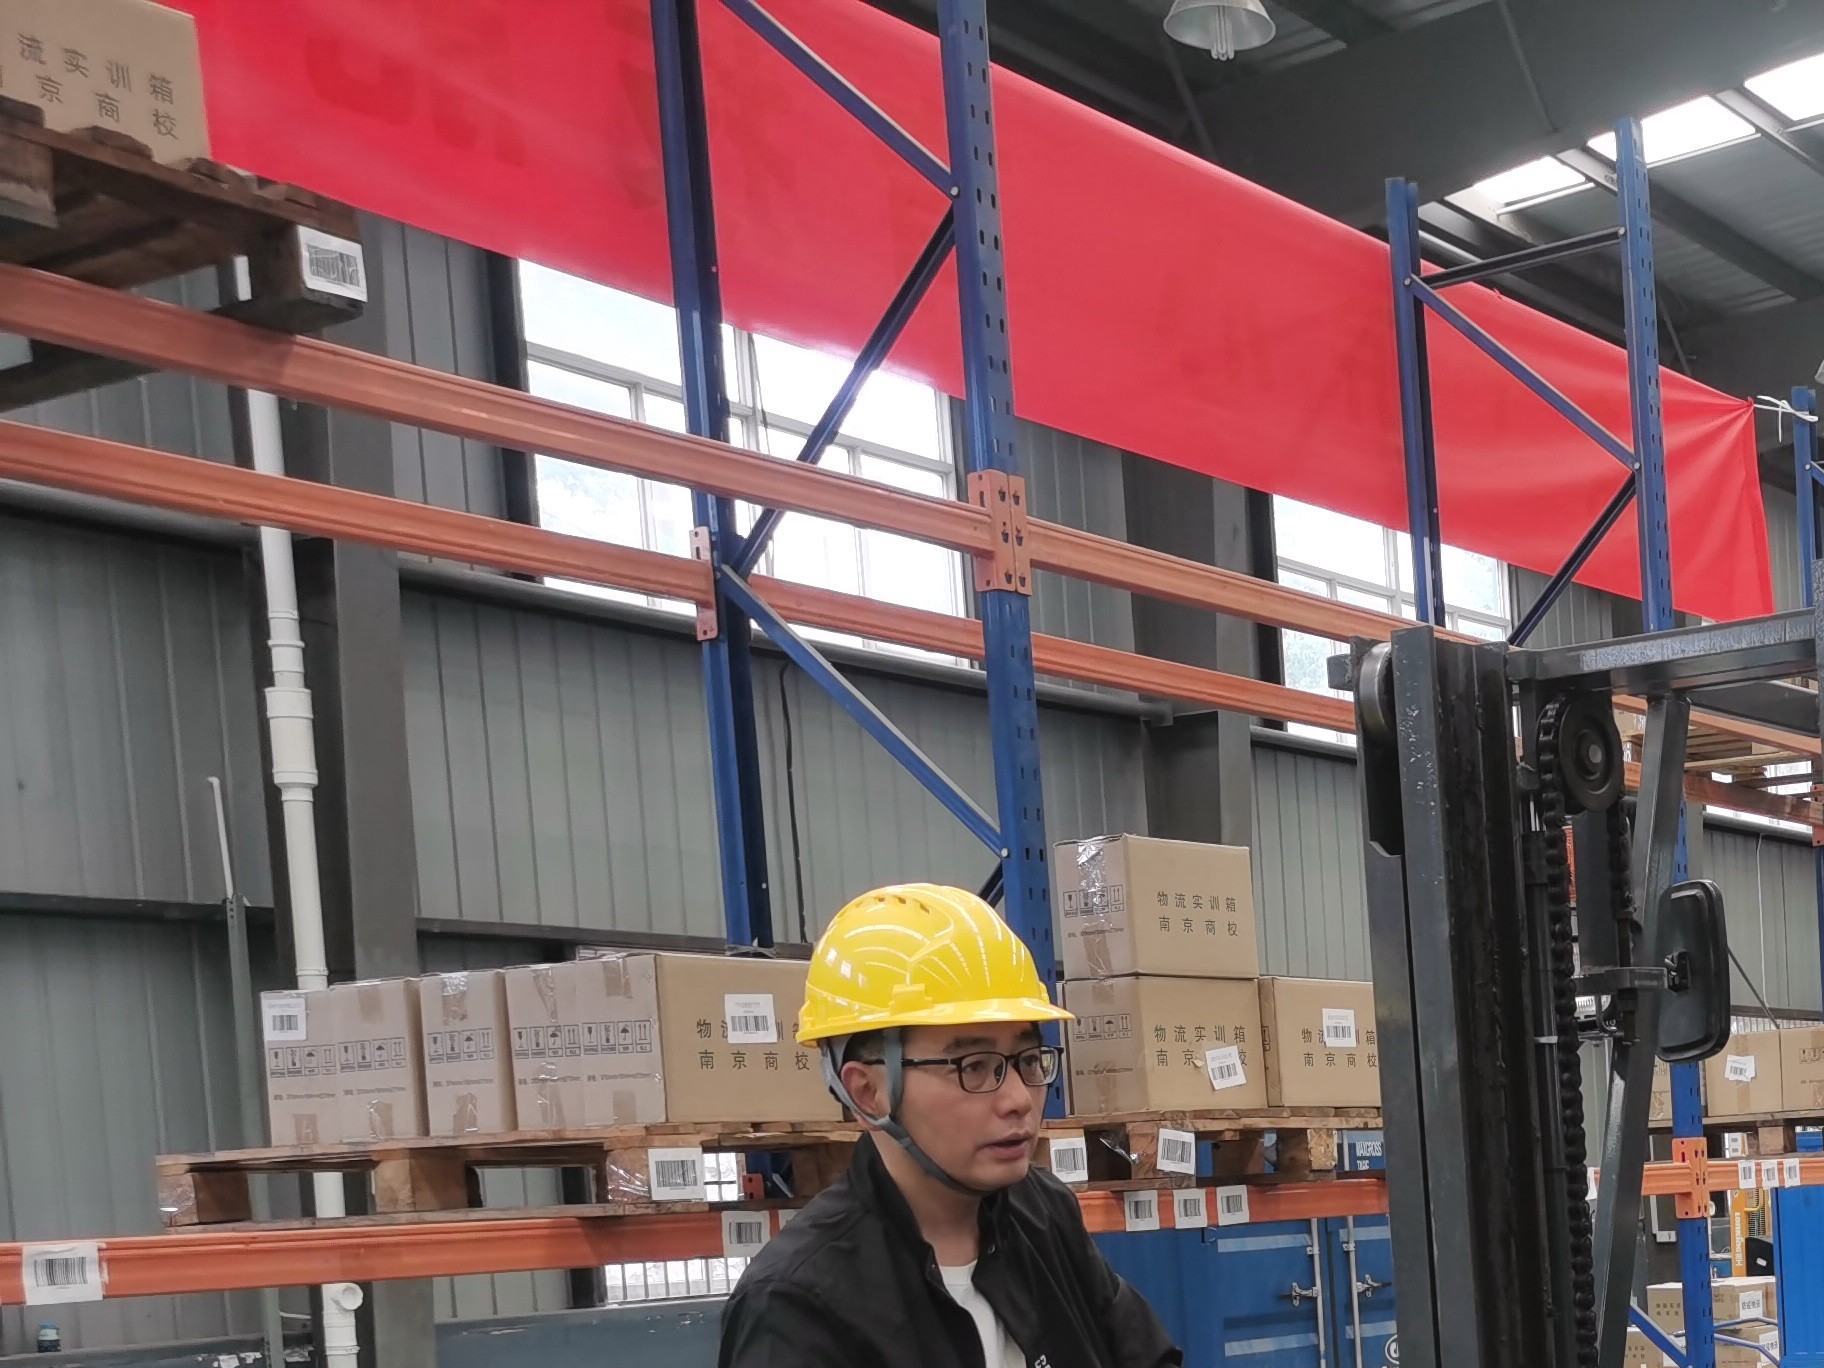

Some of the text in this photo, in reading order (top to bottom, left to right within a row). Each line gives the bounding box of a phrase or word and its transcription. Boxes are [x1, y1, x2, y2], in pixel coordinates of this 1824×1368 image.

[0, 65, 178, 140] 京商校
[1156, 891, 1237, 913] 物流实训箱
[1158, 915, 1239, 937] 南京商校
[1154, 1024, 1247, 1044] 物流实训箱
[698, 1048, 811, 1070] 南京商校
